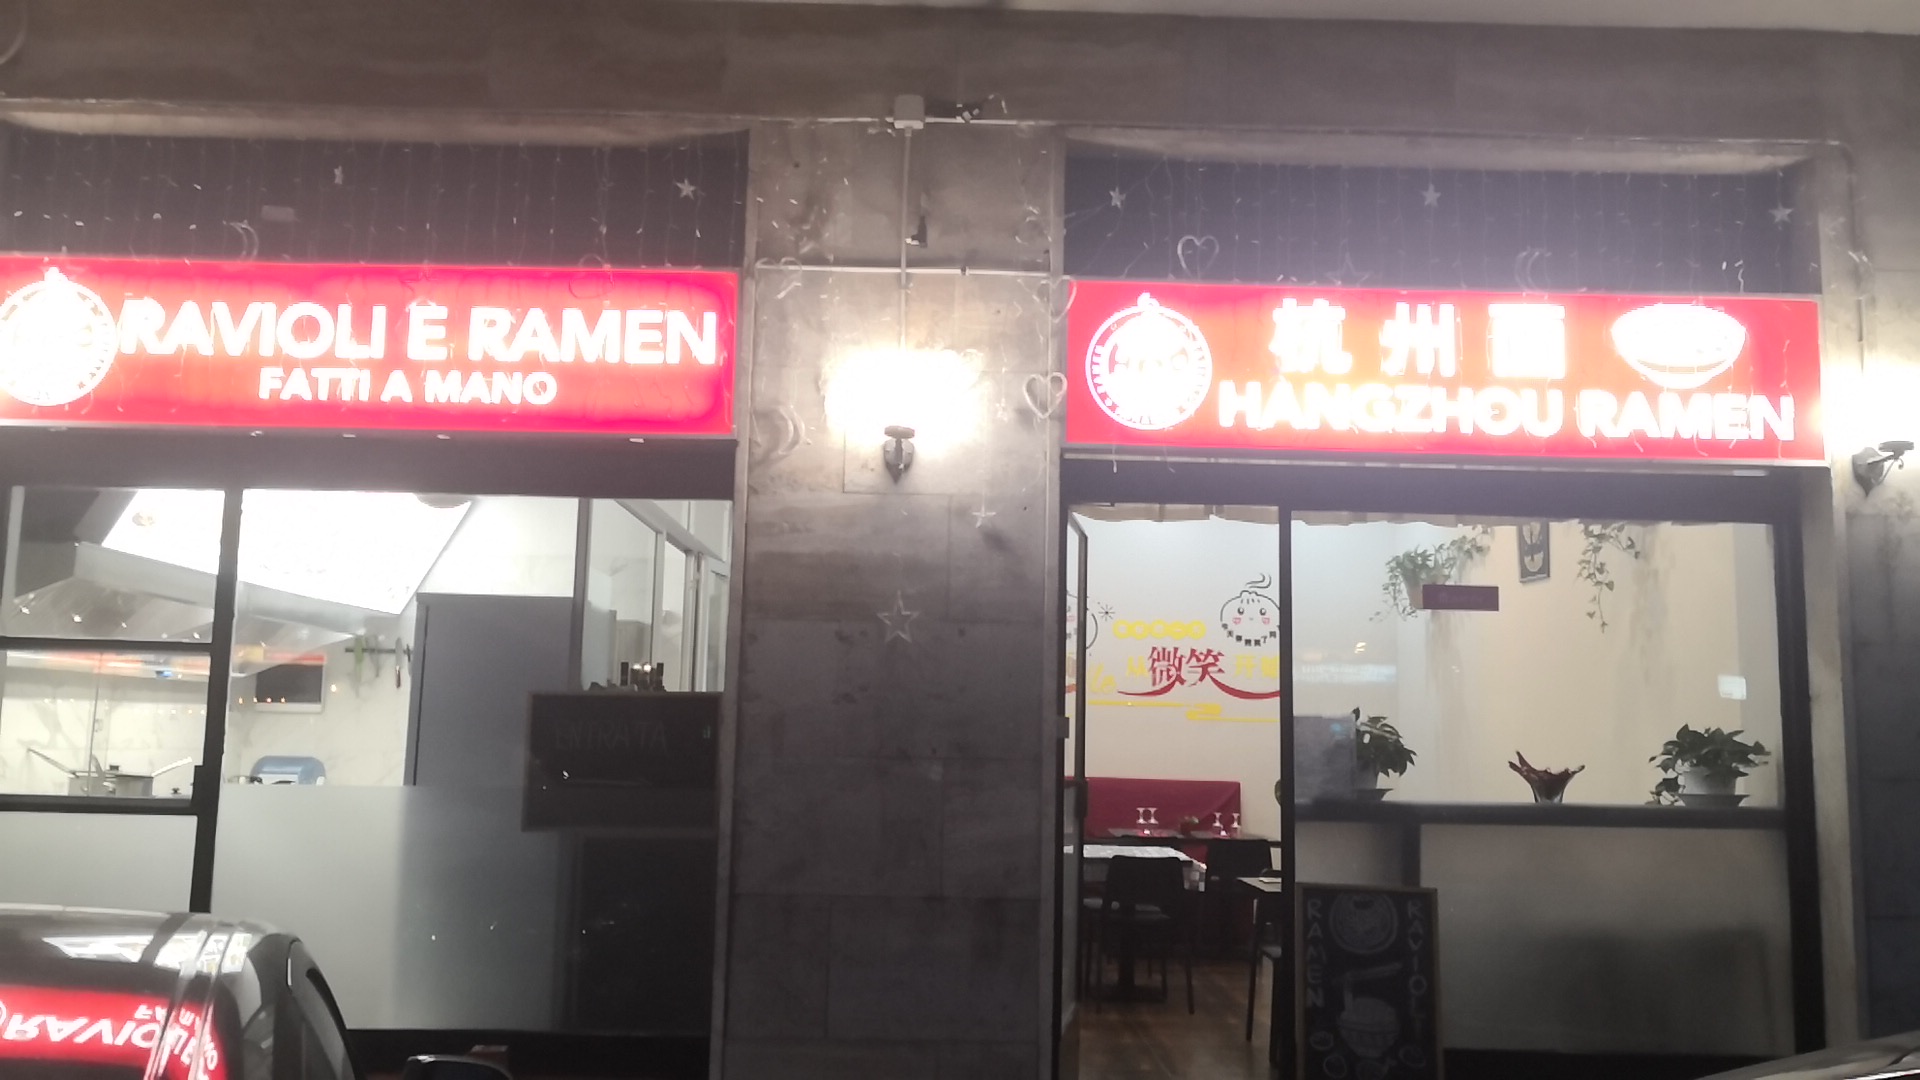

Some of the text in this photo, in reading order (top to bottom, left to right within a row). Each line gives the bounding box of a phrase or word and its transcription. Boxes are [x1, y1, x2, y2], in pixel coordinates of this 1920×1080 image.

[119, 302, 386, 359] RAVIOLI
[408, 304, 447, 362] E
[468, 307, 717, 365] RAMEN
[259, 367, 557, 404] FATTI A MANO
[1219, 381, 1795, 441] HANGZHOU RAMEN
[554, 719, 668, 754] ENTRATA
[1306, 898, 1327, 1008] RAMEN
